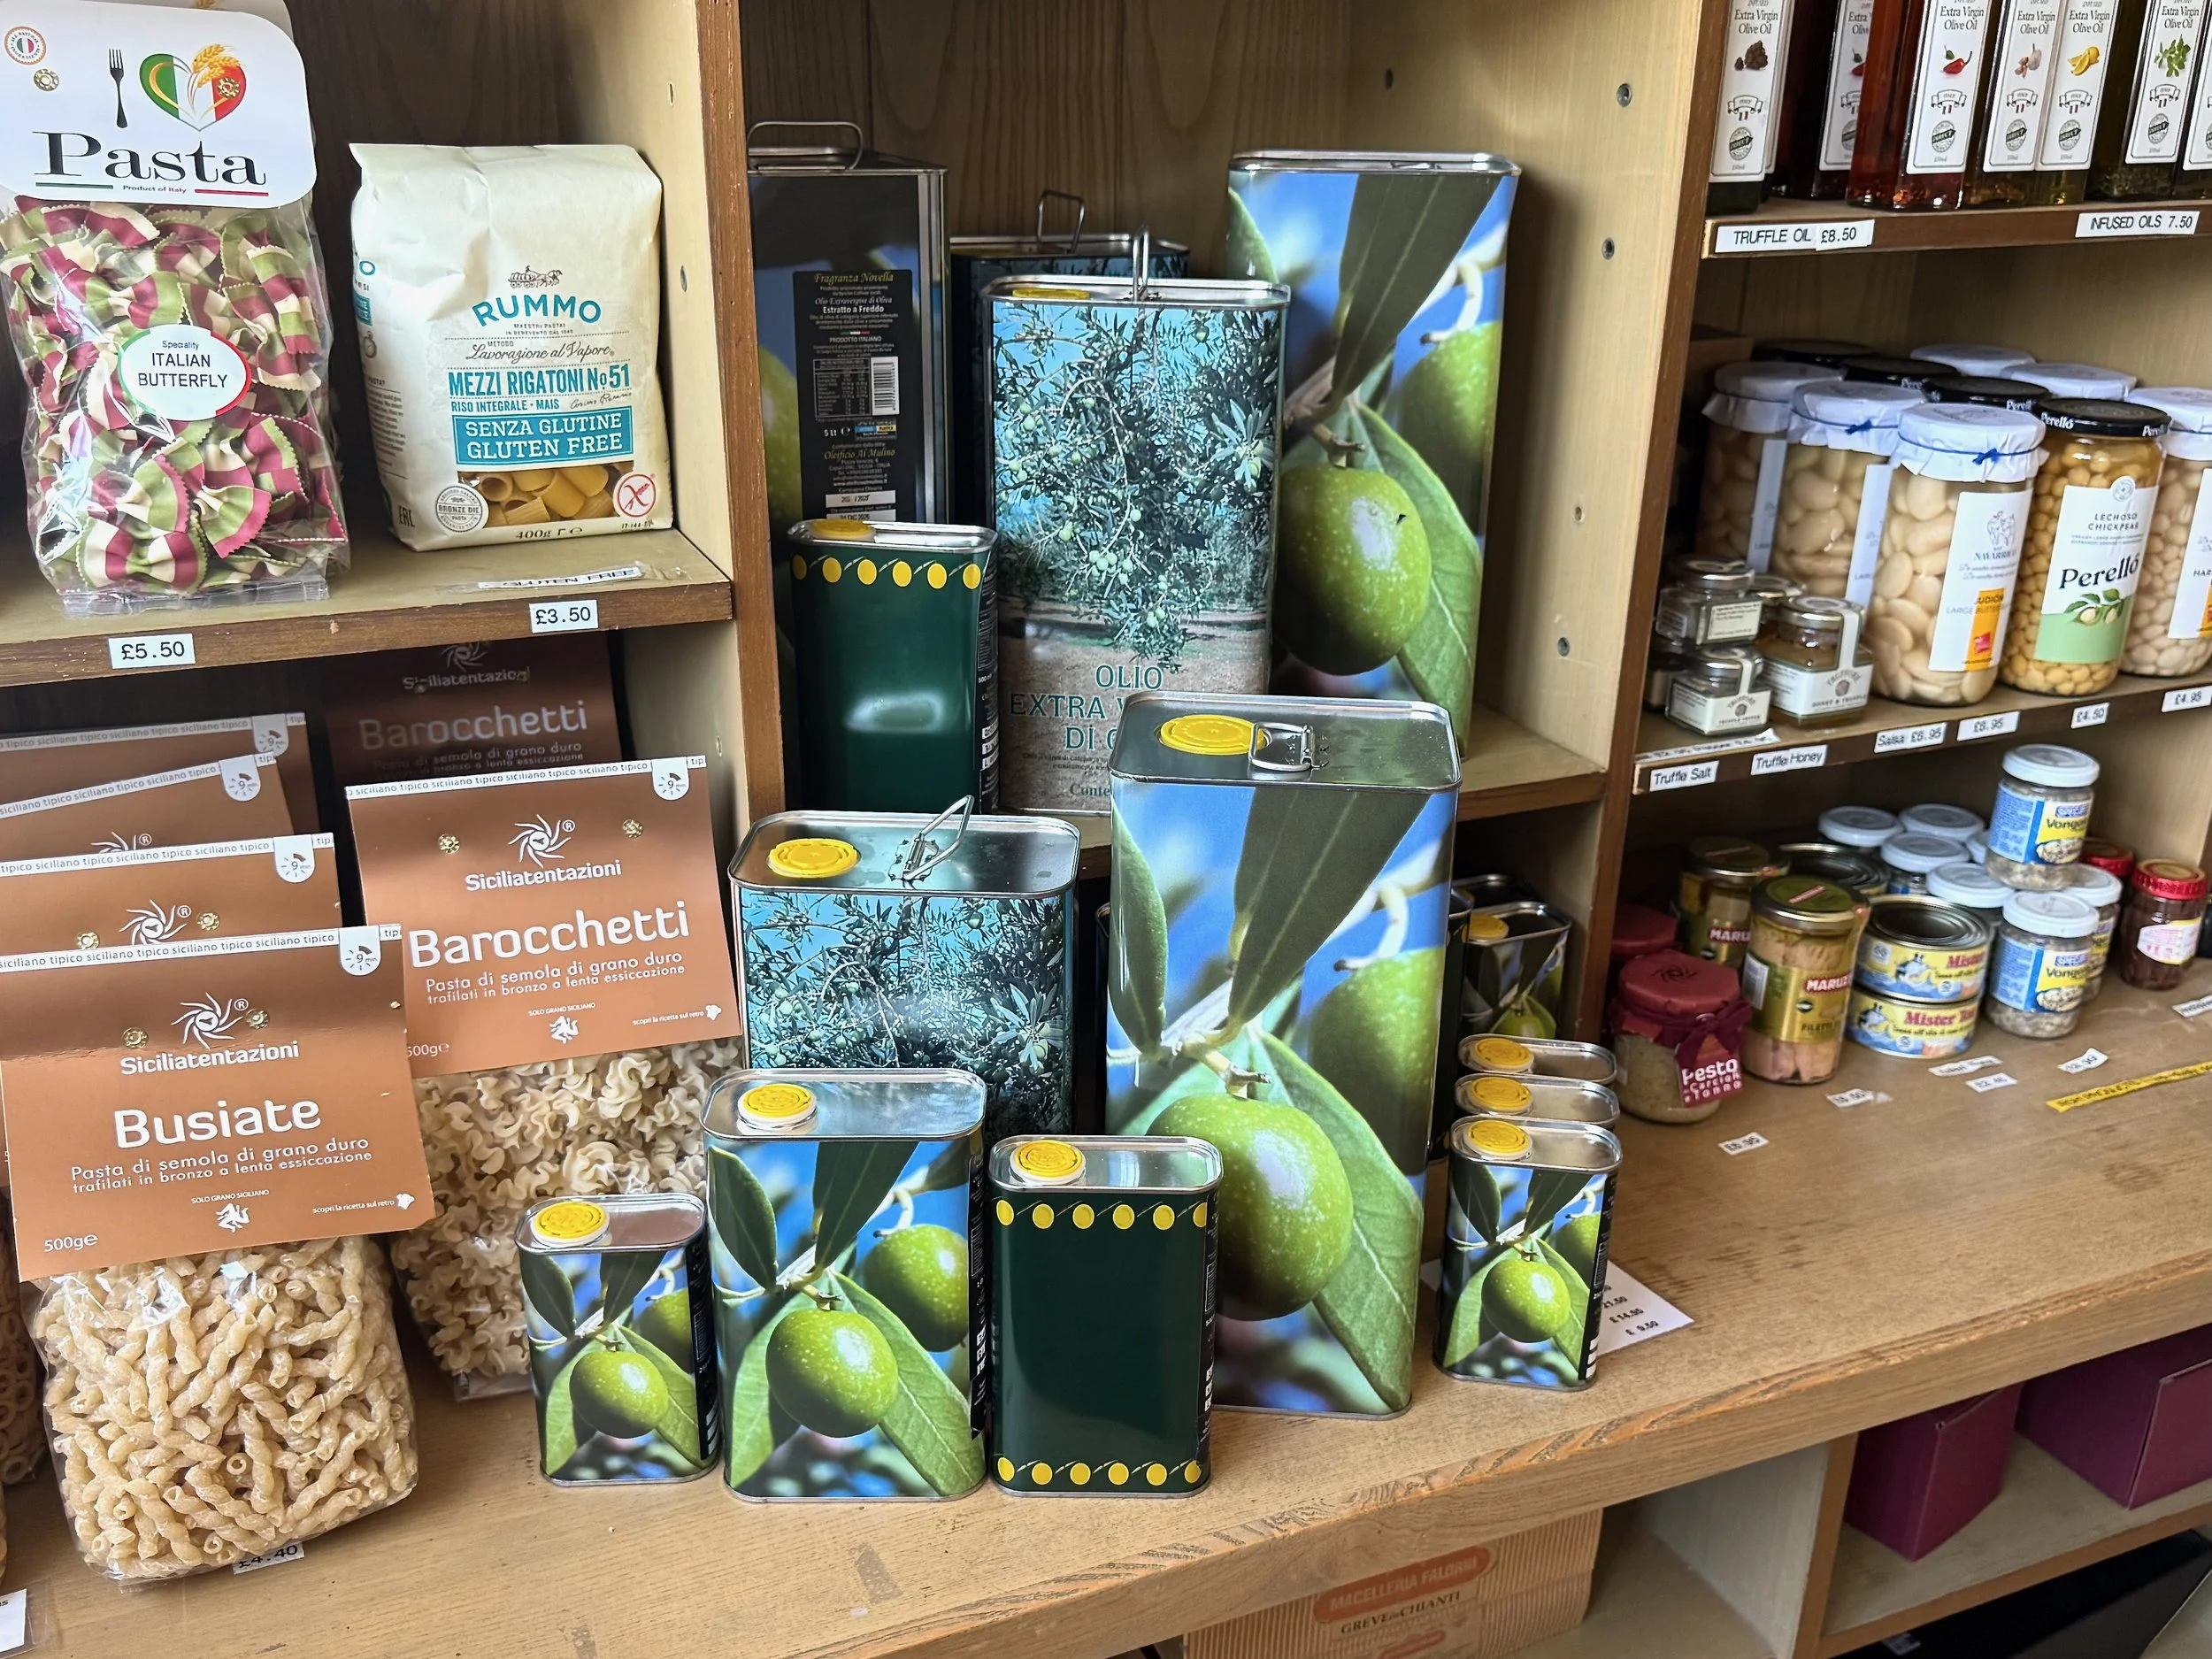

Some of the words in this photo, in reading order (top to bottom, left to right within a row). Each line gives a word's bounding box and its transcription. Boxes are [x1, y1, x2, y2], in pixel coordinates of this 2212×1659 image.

[1735, 9, 1754, 19] Extra
[1756, 10, 1778, 23] Virgin
[1848, 12, 1867, 22] Extra
[1940, 6, 1961, 17] Extra
[1963, 6, 1985, 19] Virgin
[2162, 6, 2178, 16] Extra
[2181, 6, 2200, 19] Virgin
[1739, 23, 1758, 34] Olive
[1760, 23, 1771, 34] Oil
[1944, 19, 1965, 30] Olive
[1966, 19, 1978, 30] Oil
[2164, 19, 2181, 28] Olive
[2183, 19, 2193, 28] Oil
[33, 131, 266, 186] Pasta
[123, 184, 155, 193] Product
[169, 186, 187, 195] Italy
[2139, 214, 2162, 228] OILS
[2169, 214, 2193, 229] 7.50
[1733, 230, 1787, 245] TRUFFLE
[1793, 228, 1811, 242] OIL
[1820, 227, 1857, 244] £8.50
[815, 273, 858, 285] Fragranza
[860, 272, 894, 283] Novella
[472, 295, 602, 326] RUMMO
[151, 353, 211, 367] ITALIAN
[465, 342, 549, 364] Lavorazione
[550, 343, 566, 357] al
[138, 373, 227, 388] BUTTERFLY
[449, 372, 502, 396] MEZZI
[507, 368, 584, 395] RIGATONI
[451, 401, 473, 412] RISO
[477, 400, 527, 412] INTEGRALE
[536, 399, 559, 410] MAIS
[2007, 399, 2032, 412] Perell
[465, 417, 534, 438] SENZA
[539, 413, 622, 434] GLUTINE
[467, 439, 559, 460] GLUTEN
[568, 433, 622, 455] FREE
[438, 504, 465, 513] BRONZE
[468, 505, 480, 514] DIE
[515, 529, 551, 539] 400g
[2088, 522, 2139, 531] CHICKPEAS
[503, 577, 579, 586] GLUTEN
[588, 570, 636, 580] FREE
[2059, 552, 2140, 589] Perelló
[535, 606, 591, 625] £3.50
[121, 641, 186, 661] £5.50
[1096, 664, 1164, 690] OLIO
[1010, 694, 1108, 719] EXTRA
[358, 701, 588, 750] Barocchetti
[1066, 725, 1095, 750] DI
[1878, 734, 1904, 747] Salsa
[1755, 755, 1789, 770] Truffle
[1790, 750, 1823, 766] Honey
[1654, 770, 1687, 787] Truffle
[1691, 766, 1712, 780] Salt
[1070, 785, 1111, 796] Conte
[465, 859, 622, 892] Siciliatentazioni
[410, 900, 690, 969] Barocchetti
[0, 956, 46, 969] siciliano
[50, 953, 83, 965] tipico
[86, 949, 134, 961] siciliano
[136, 945, 169, 957] tipico
[172, 941, 218, 954] siciliano
[220, 938, 253, 951] tipico
[256, 934, 300, 948] siciliano
[303, 933, 334, 945] tipico
[357, 953, 364, 964] 9
[426, 977, 471, 994] Pasta
[478, 972, 494, 987] di
[501, 965, 561, 984] semola
[567, 960, 583, 976] di
[590, 956, 639, 976] grano
[645, 950, 682, 966] duro
[427, 988, 478, 1004] trafilati
[484, 985, 496, 997] in
[502, 979, 548, 995] bronzo
[553, 979, 561, 989] a
[565, 973, 599, 987] lenta
[604, 964, 685, 983] essiccazione
[1906, 1011, 1957, 1025] Mister
[120, 1041, 299, 1075] Siciliatentazioni
[1694, 1080, 1742, 1101] Tonno
[114, 1098, 322, 1148] Busiate
[71, 1165, 124, 1181] Pasta
[133, 1158, 151, 1173] di
[158, 1152, 229, 1171] semola
[237, 1146, 255, 1161] di
[263, 1142, 319, 1164] grano
[326, 1136, 369, 1152] duro
[73, 1177, 133, 1194] trafilati
[139, 1174, 153, 1187] in
[160, 1169, 213, 1183] bronzo
[219, 1167, 229, 1177] a
[234, 1159, 273, 1174] lenta
[279, 1151, 373, 1170] essiccazione
[211, 1193, 236, 1202] GRANO
[236, 1188, 270, 1201] SICILIANO
[313, 1204, 335, 1215] scopri
[343, 1201, 365, 1211] ricetta
[366, 1200, 377, 1209] sul
[378, 1198, 395, 1208] retro
[1331, 1576, 1417, 1611] MACELLERIA
[1421, 1556, 1477, 1585] FALORNI
[1341, 1612, 1390, 1635] GREVE
[1400, 1591, 1461, 1617] CHIANTI
